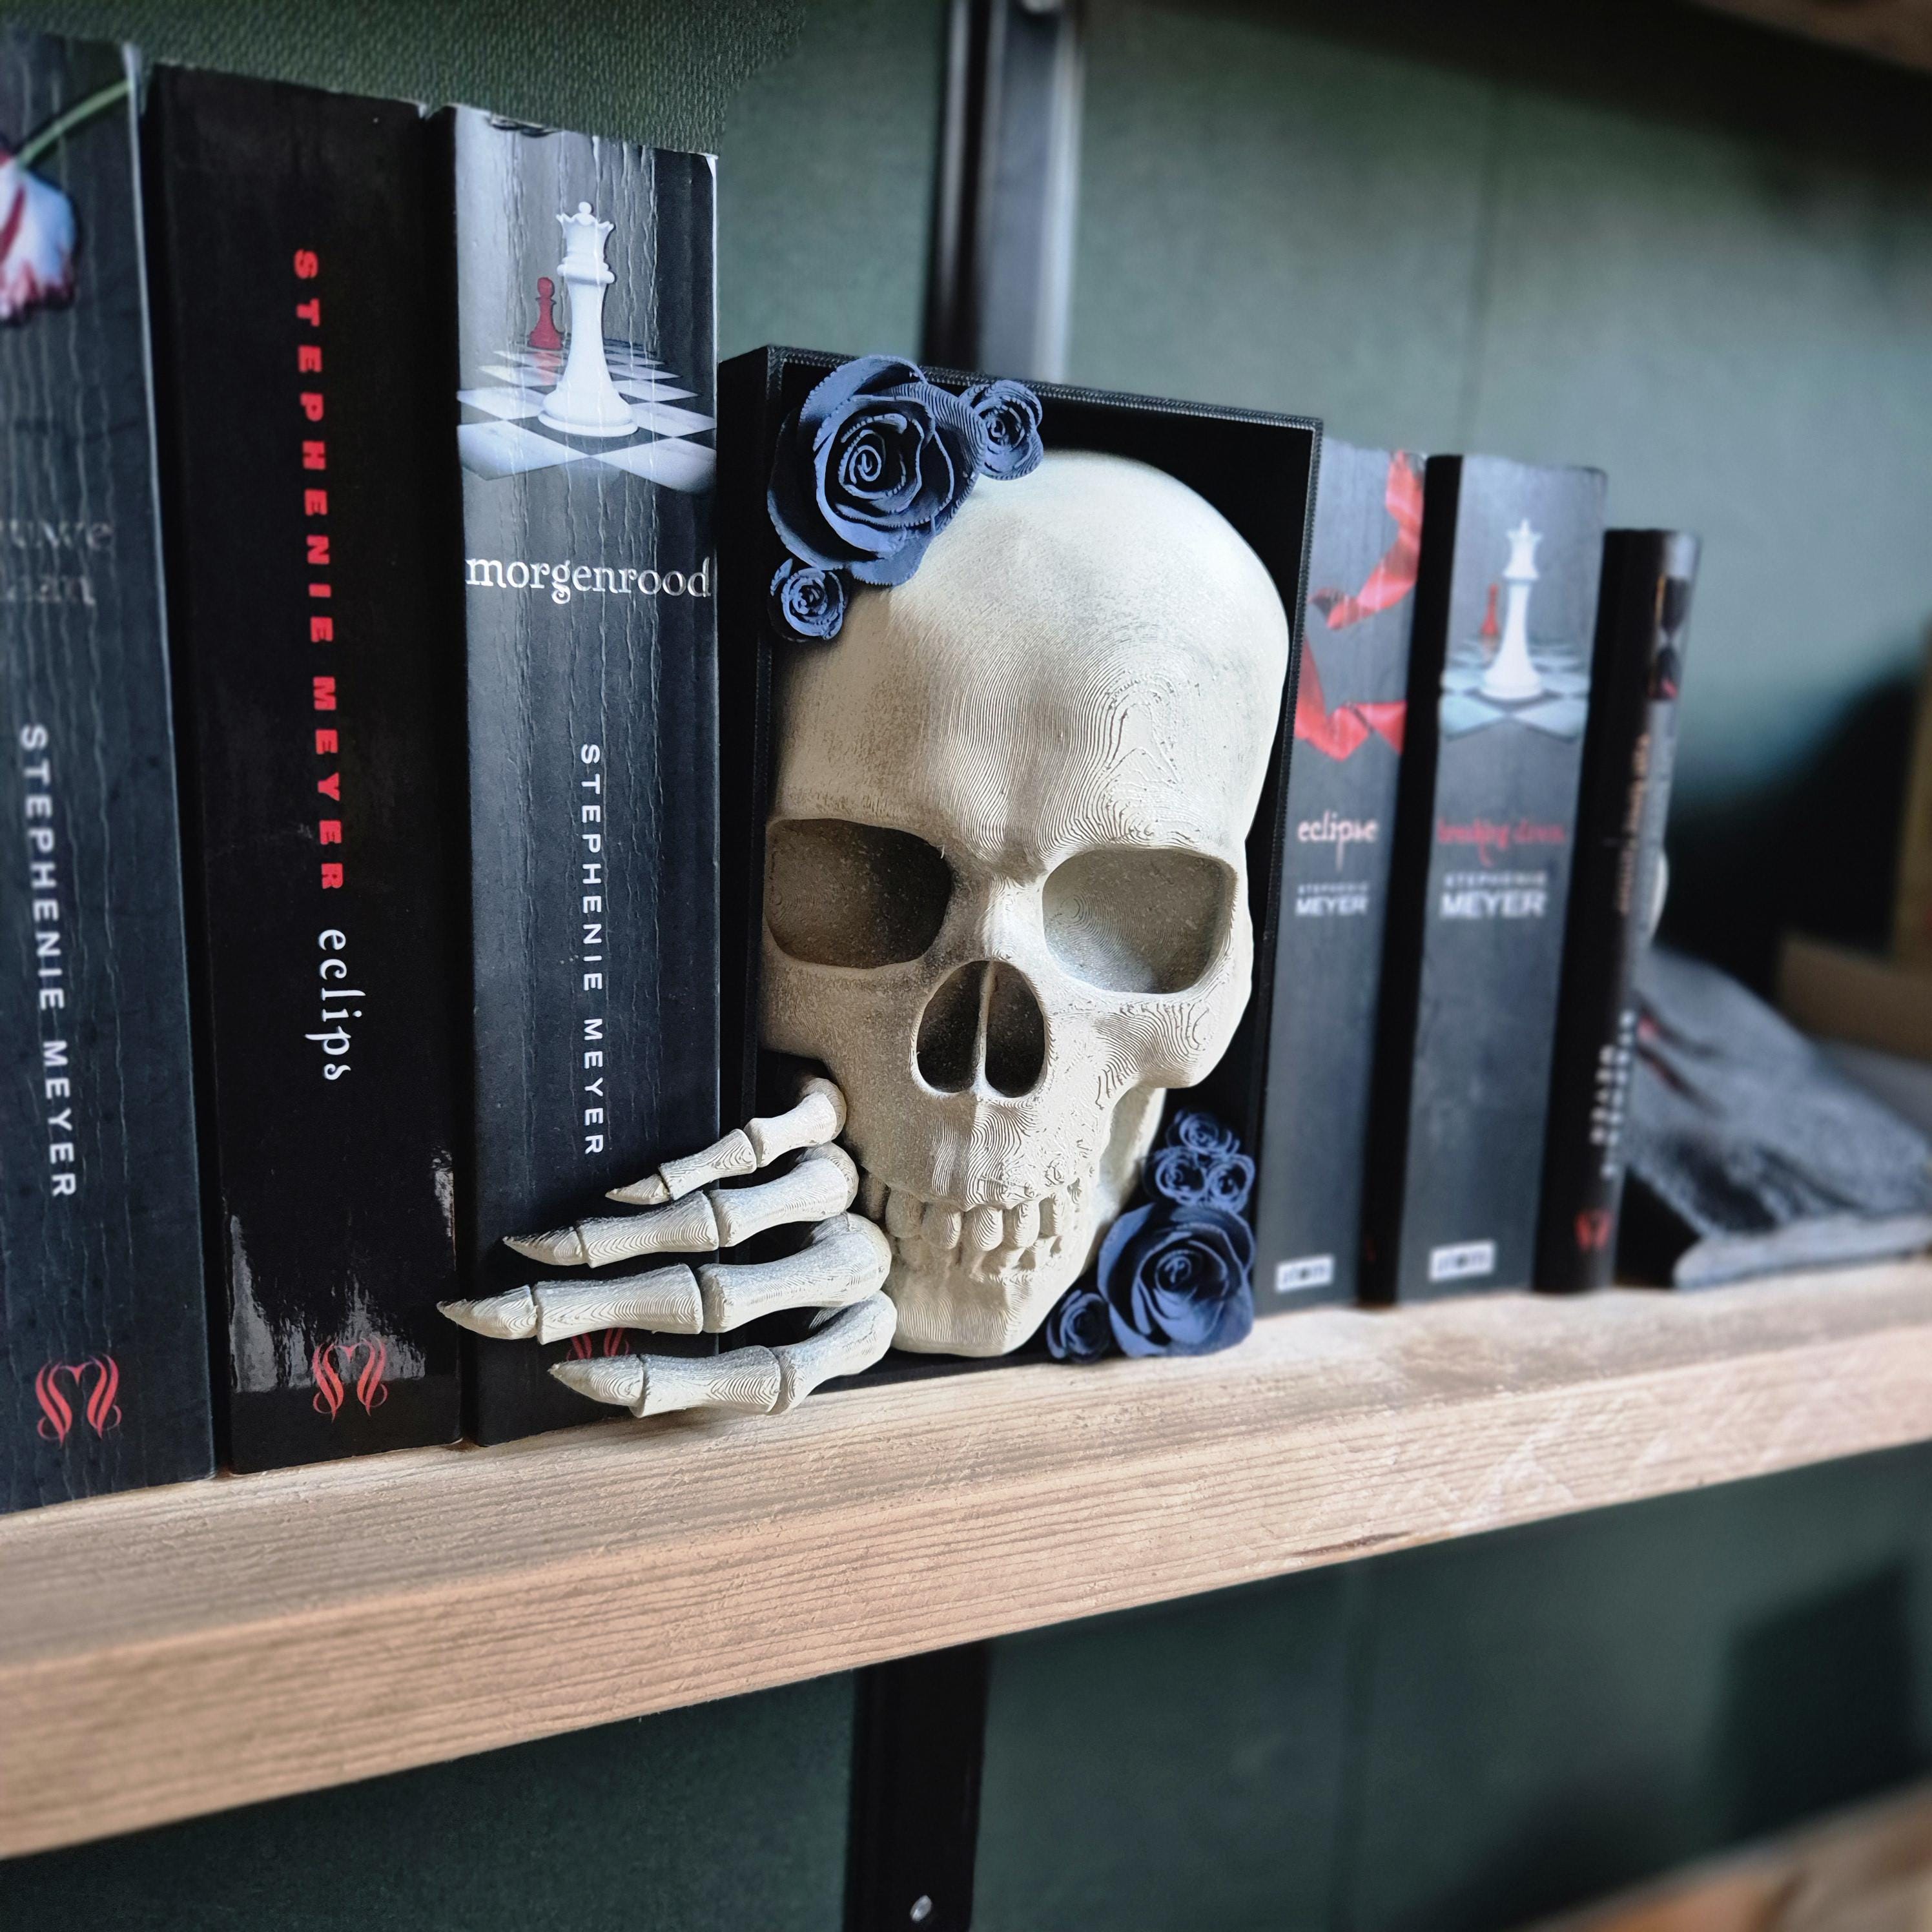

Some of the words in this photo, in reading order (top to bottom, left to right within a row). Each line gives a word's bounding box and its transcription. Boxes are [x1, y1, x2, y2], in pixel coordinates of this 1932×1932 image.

[294, 249, 334, 642] STEPHENIE
[465, 557, 712, 604] morgenrood
[313, 676, 344, 889] MEYER
[1297, 810, 1378, 872] eclipse
[581, 744, 603, 991] STEPHENIE
[1295, 894, 1368, 917] MEYER
[1439, 889, 1547, 919] MEYER
[19, 723, 65, 1011] STEPHENIE
[42, 1040, 77, 1197] MEYER
[304, 929, 366, 1081] eclips
[583, 1018, 604, 1155] MEYER
